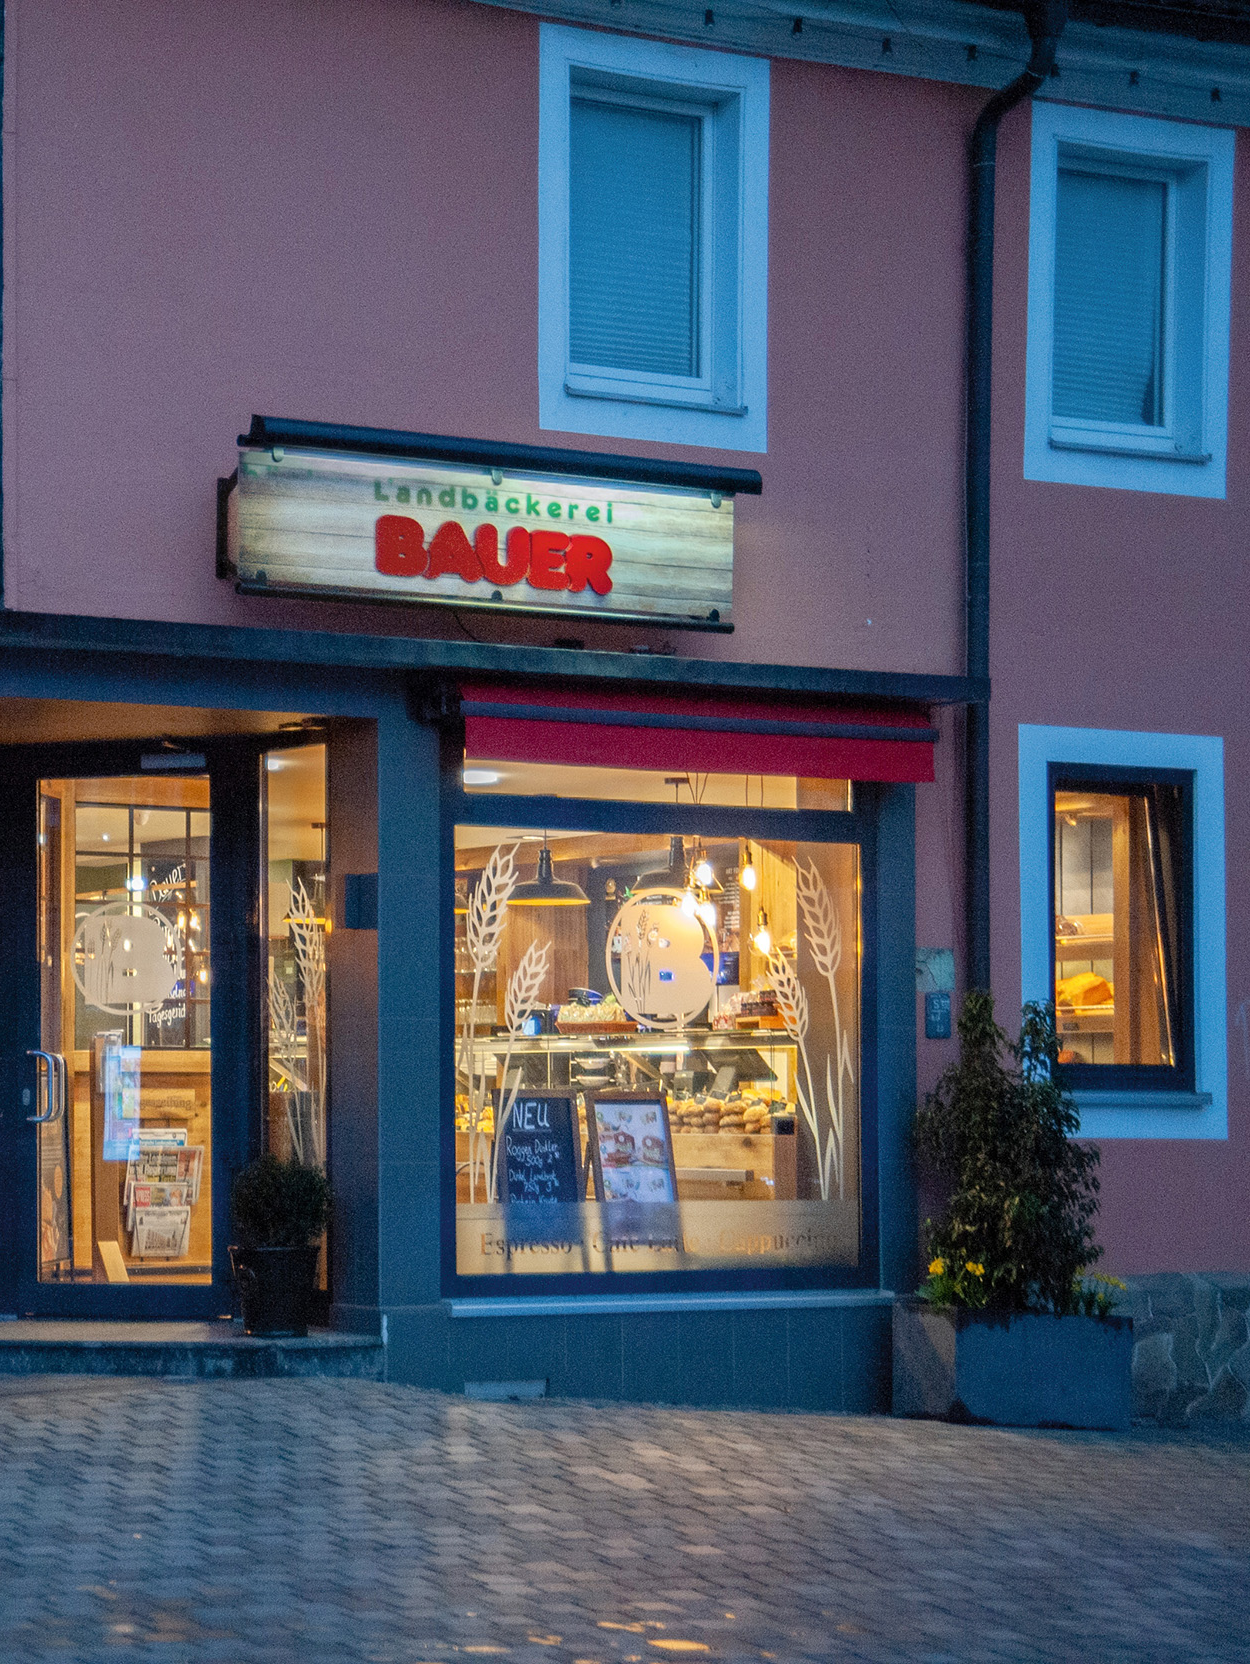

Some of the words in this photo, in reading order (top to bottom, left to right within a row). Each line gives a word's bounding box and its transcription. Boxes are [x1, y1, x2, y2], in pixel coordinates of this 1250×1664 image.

[374, 480, 613, 523] Landbäckerei
[375, 514, 613, 596] BAUER
[513, 1102, 550, 1130] NEU
